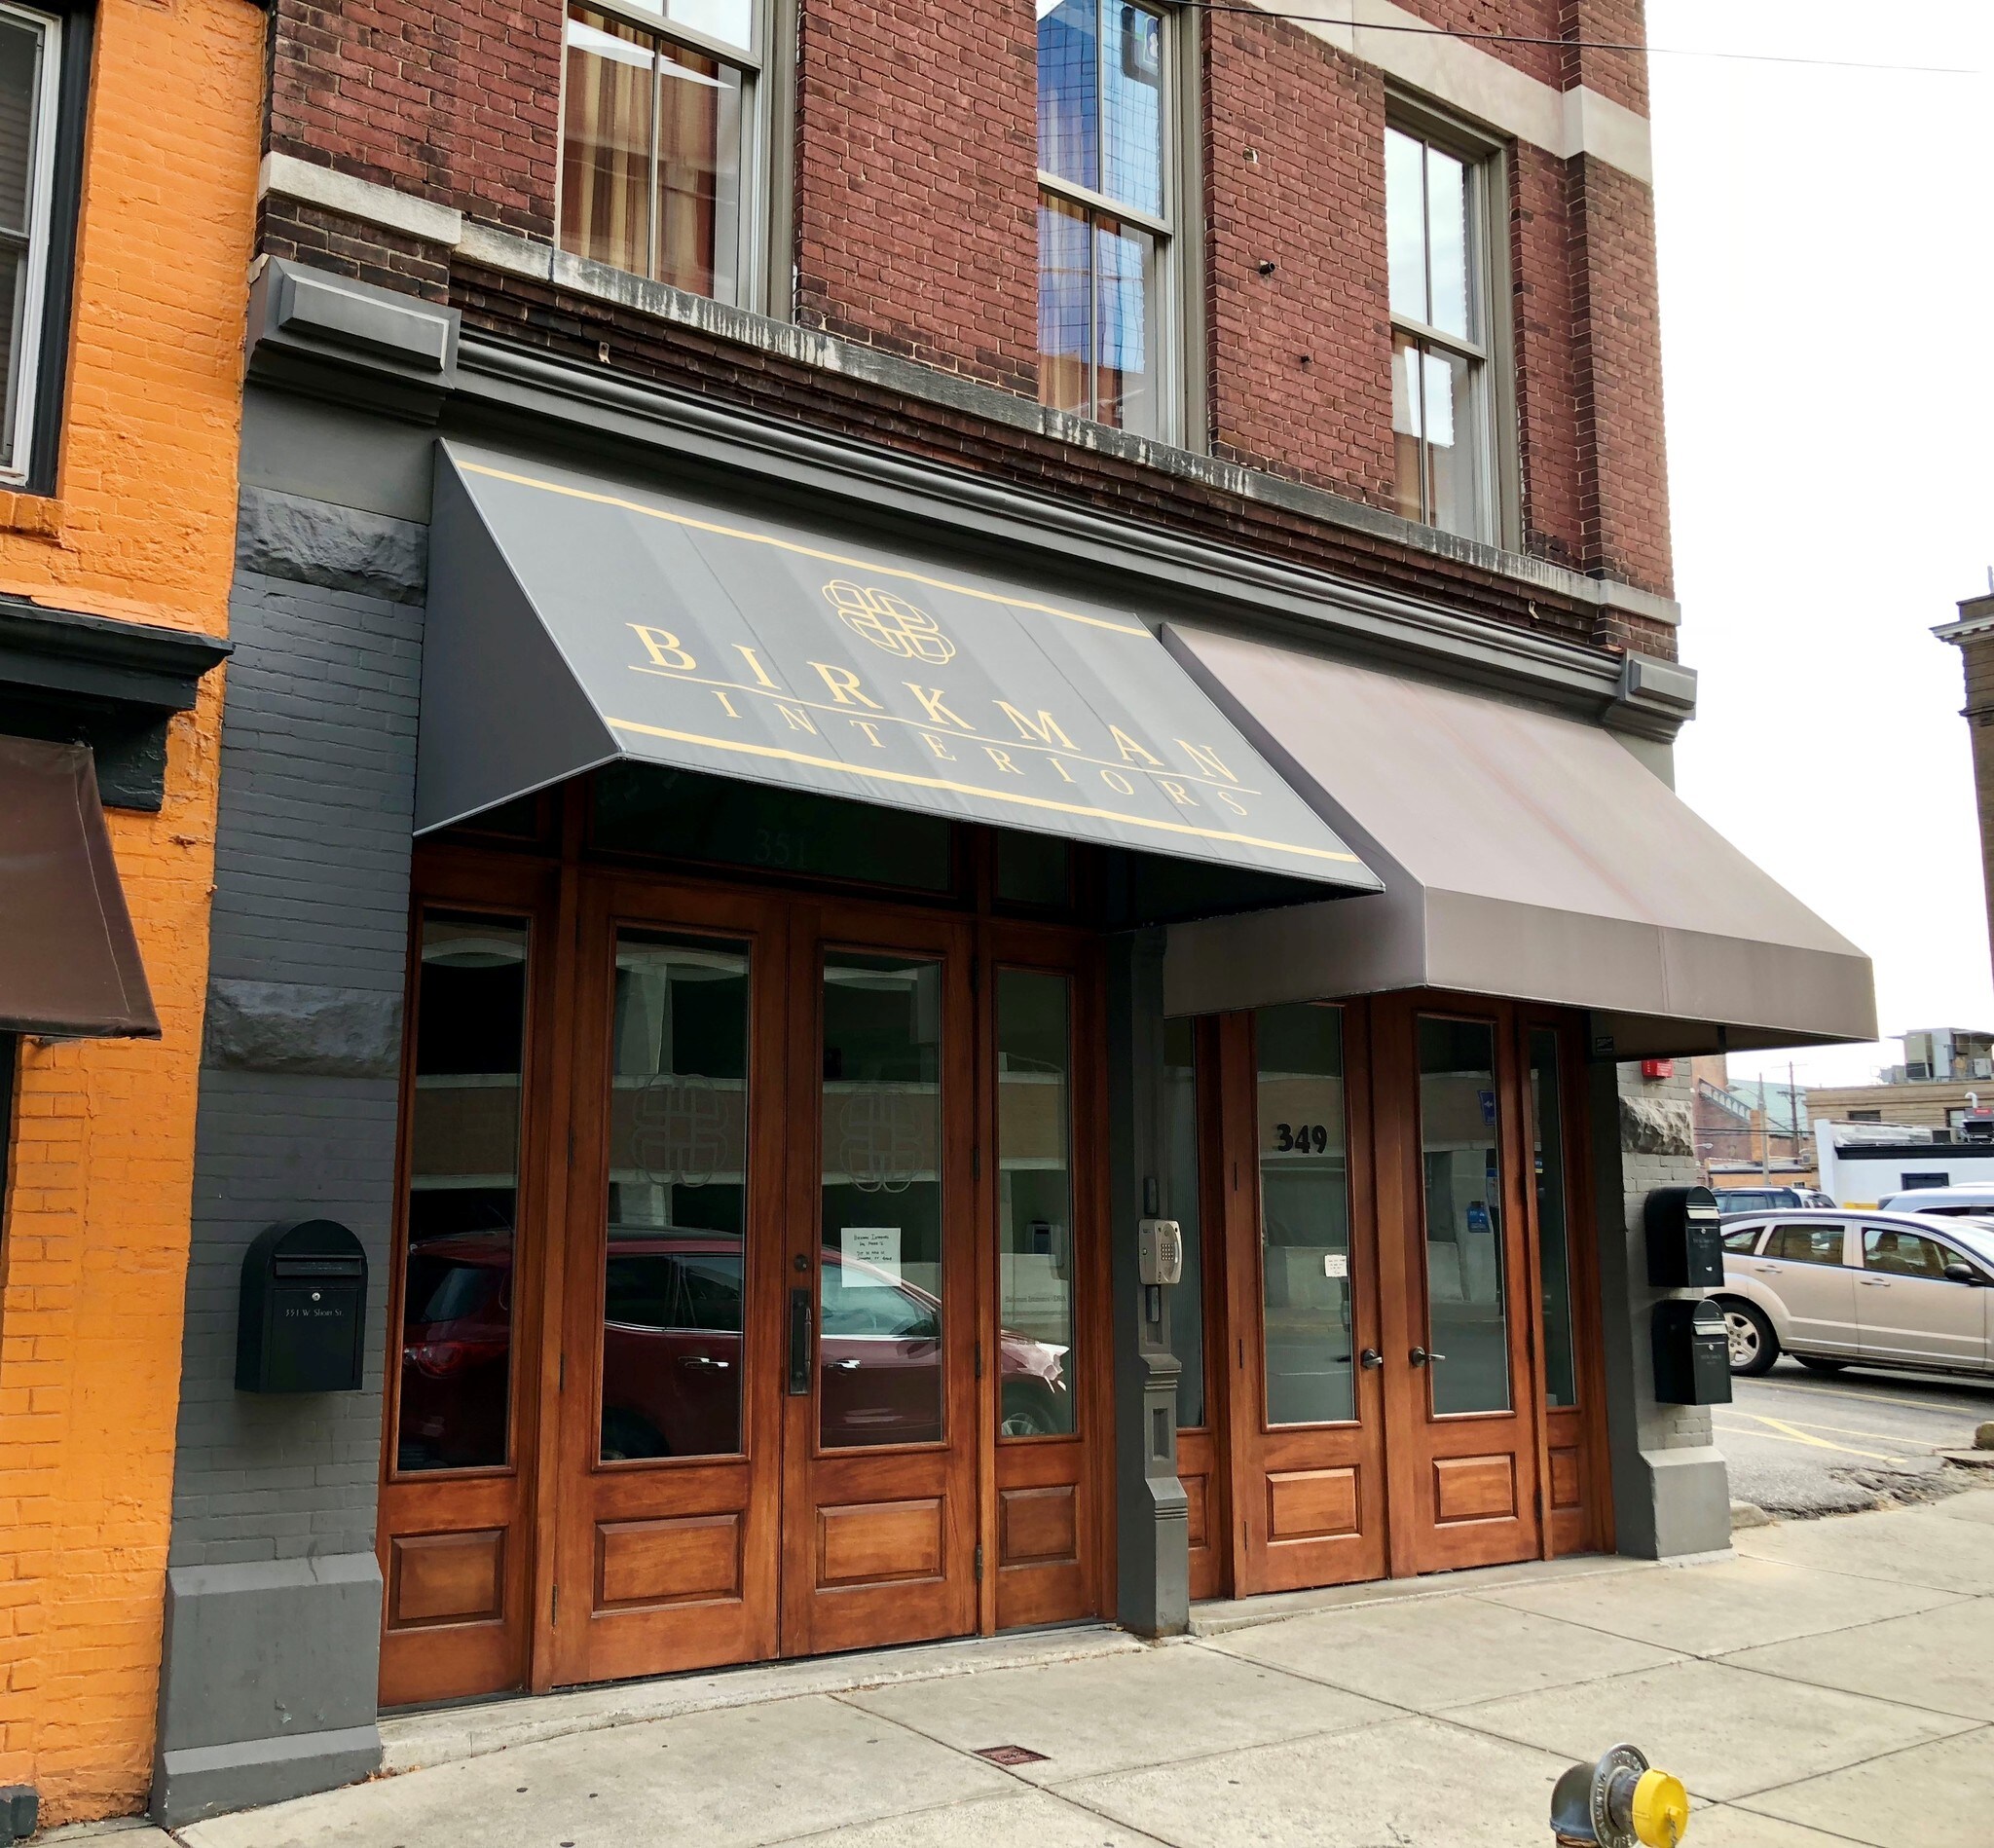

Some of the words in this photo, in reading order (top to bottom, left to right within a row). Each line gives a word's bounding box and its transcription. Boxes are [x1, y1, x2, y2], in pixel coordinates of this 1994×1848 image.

[626, 623, 1240, 783] BIRKMAN
[711, 690, 1249, 817] INTERIORS
[755, 829, 810, 871] 351
[1276, 1123, 1328, 1155] 349
[285, 1309, 300, 1317] 351
[302, 1309, 311, 1317] W
